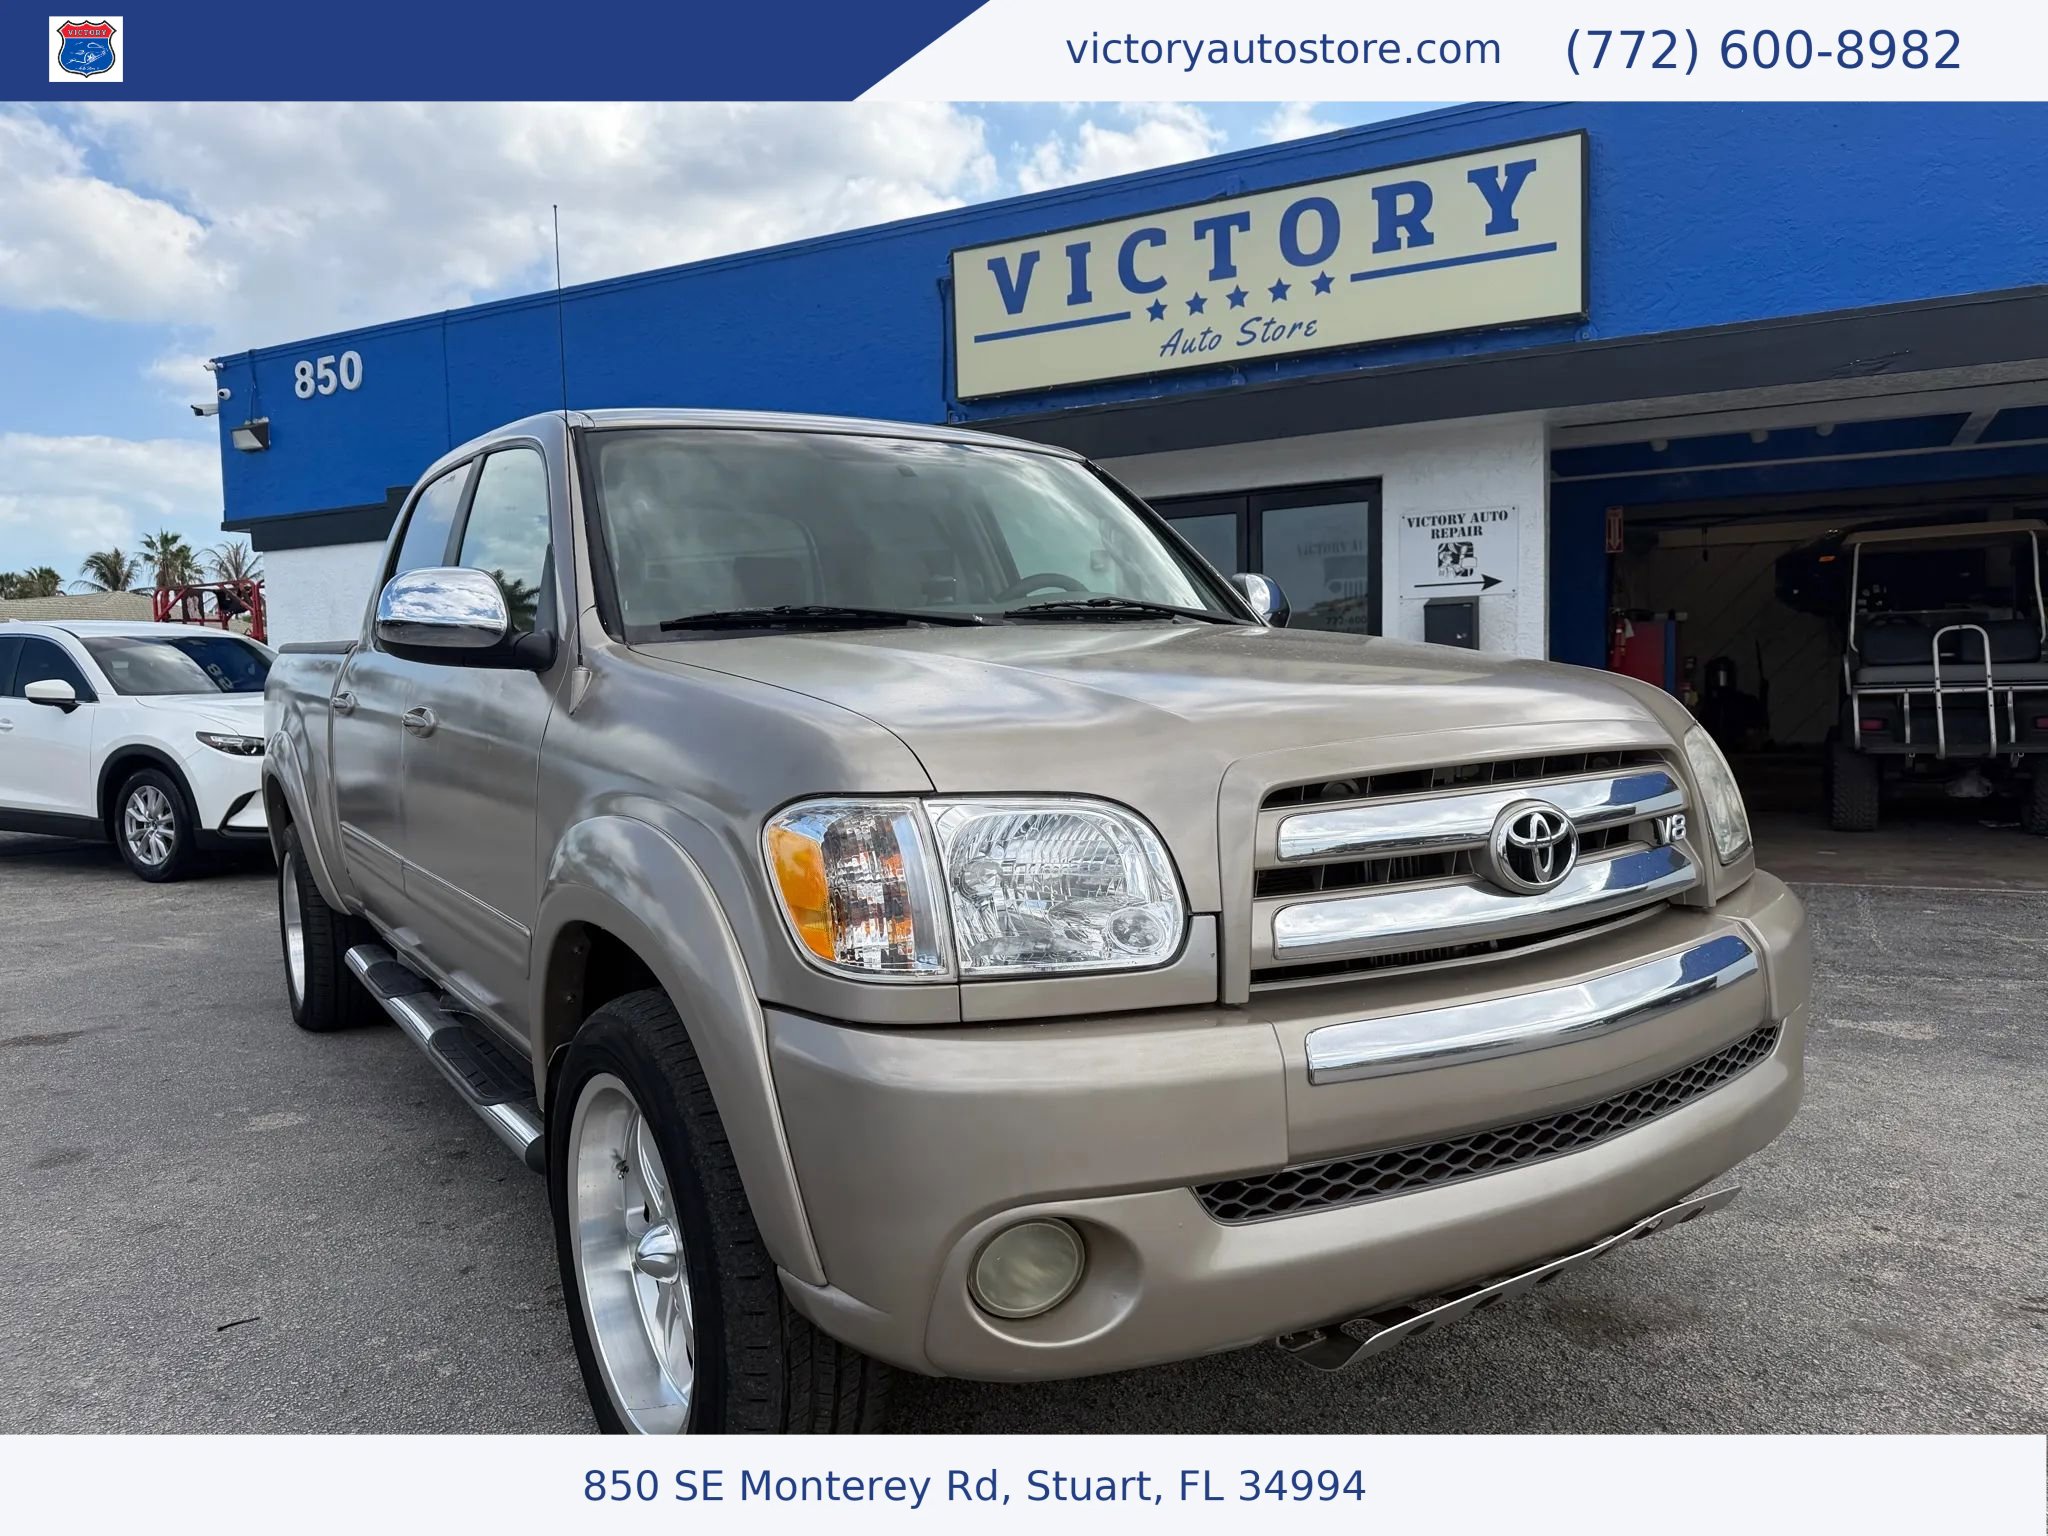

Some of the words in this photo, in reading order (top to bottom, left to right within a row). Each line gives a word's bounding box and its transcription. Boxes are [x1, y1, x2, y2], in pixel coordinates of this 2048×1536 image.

[987, 158, 1538, 317] VICTORY
[1159, 325, 1223, 358] Auto
[1235, 315, 1319, 347] Store
[294, 350, 363, 399] 850
[1407, 512, 1466, 528] VICTORY
[1470, 509, 1509, 524] AUTO
[1431, 525, 1483, 540] REPAIR
[1655, 814, 1687, 845] V8
